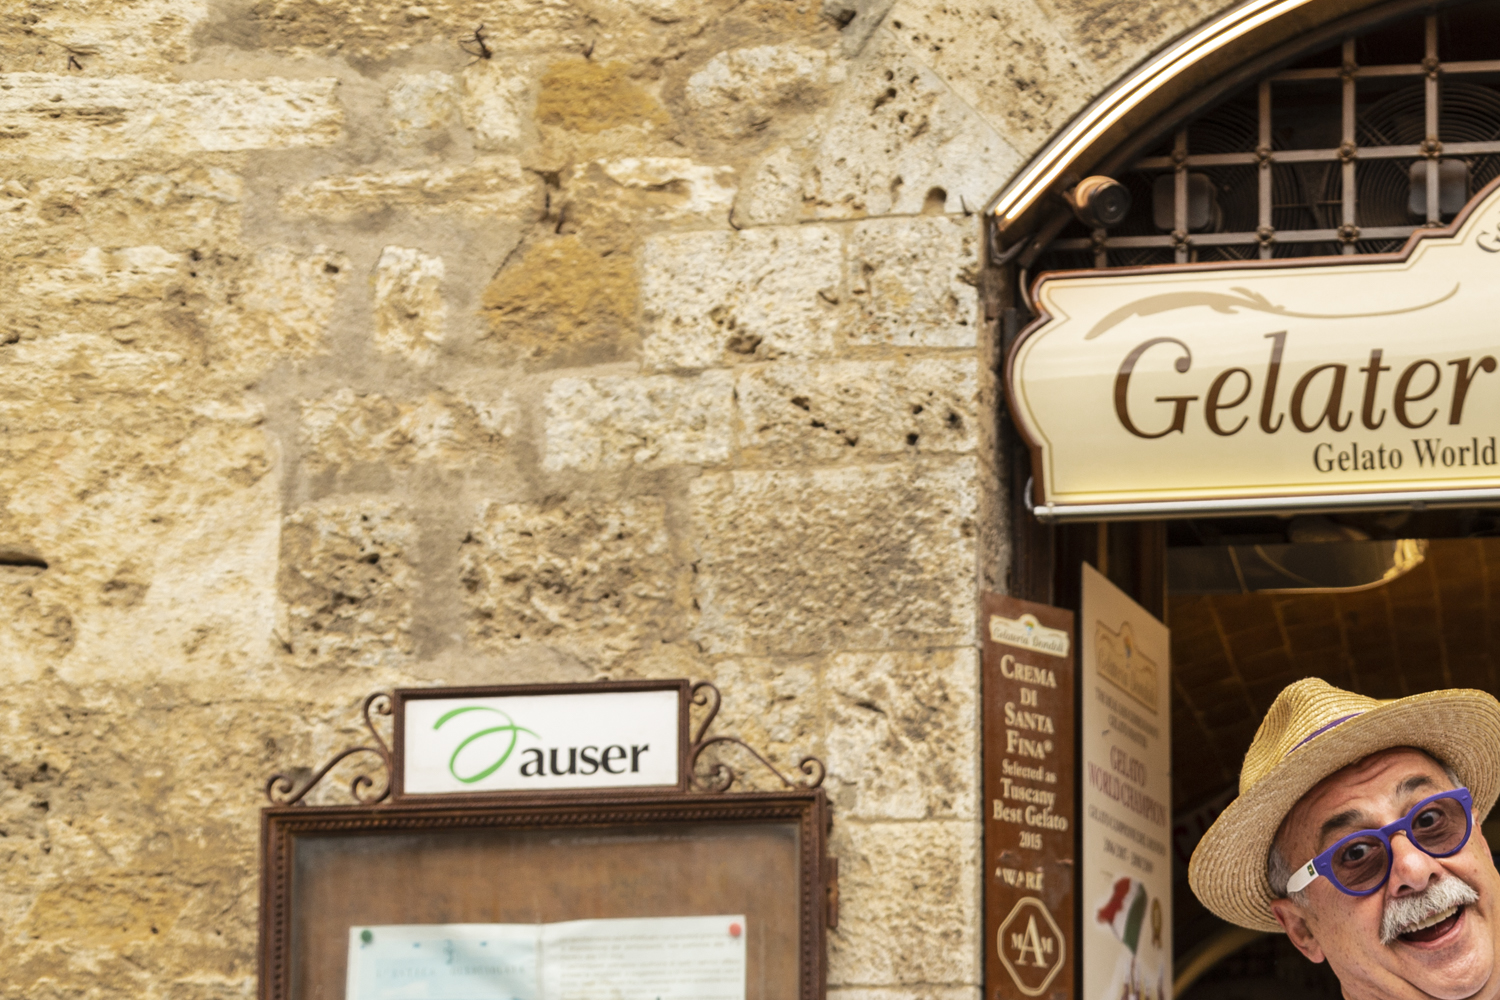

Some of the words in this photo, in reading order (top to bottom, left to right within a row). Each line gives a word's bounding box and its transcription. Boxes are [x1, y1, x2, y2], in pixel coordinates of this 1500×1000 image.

[1313, 442, 1402, 472] Gelato
[1411, 436, 1498, 468] World
[1000, 654, 1057, 688] CREMA
[1020, 687, 1038, 707] DI
[1004, 701, 1054, 734] SANTA
[520, 741, 650, 777] auser
[1002, 758, 1044, 782] Selected
[1045, 771, 1057, 783] as
[1000, 777, 1056, 812] Tuscany
[993, 799, 1023, 824] Best
[1025, 805, 1068, 832] Gelato
[1019, 831, 1042, 850] 2015
